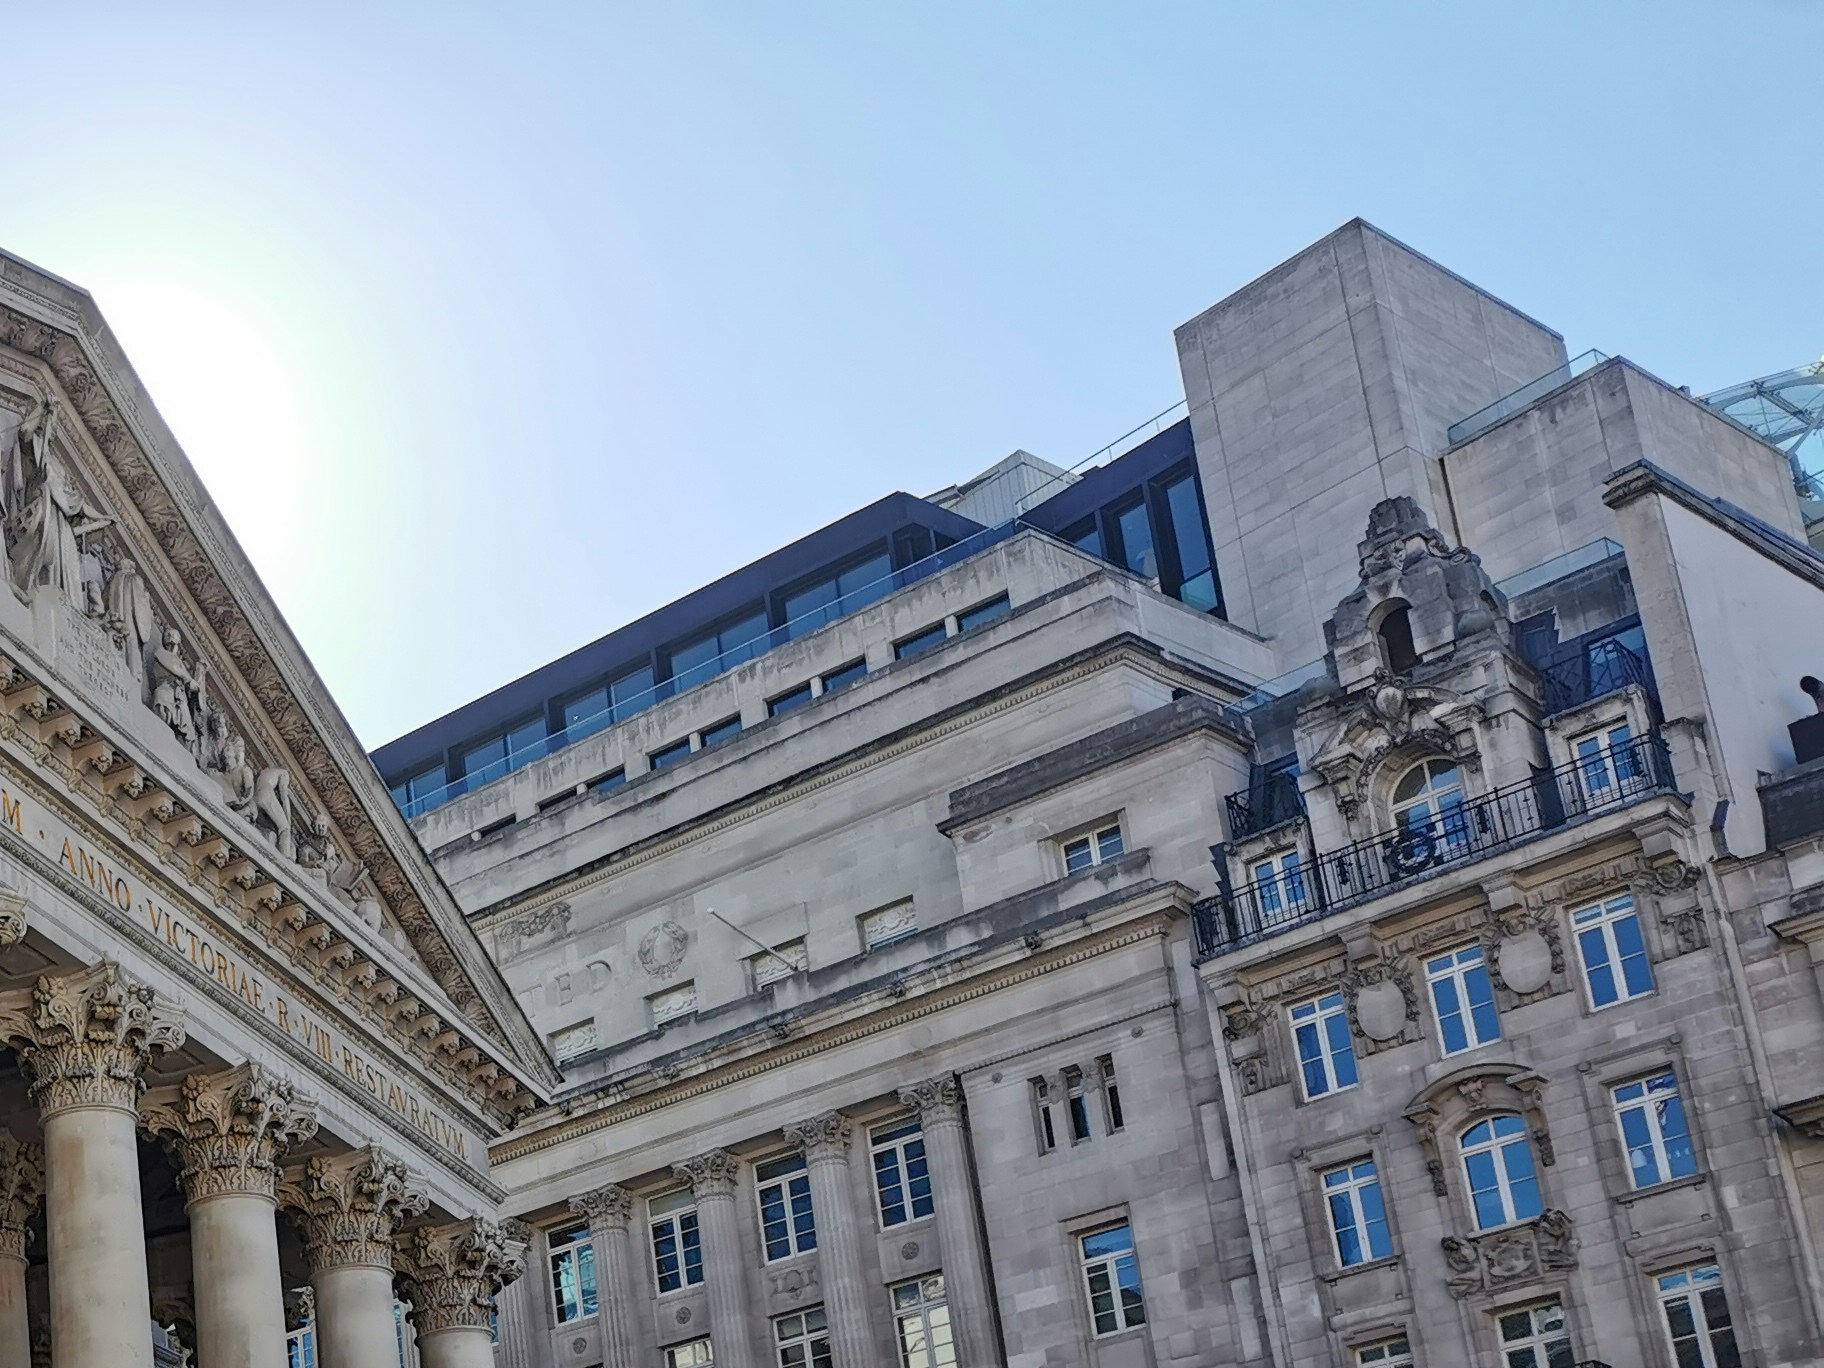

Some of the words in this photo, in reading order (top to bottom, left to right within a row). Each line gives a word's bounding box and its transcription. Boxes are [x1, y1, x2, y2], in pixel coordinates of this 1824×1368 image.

[59, 837, 131, 912] ANNO
[146, 898, 266, 1014] VICTORIAE
[277, 997, 291, 1034] R
[301, 1014, 333, 1064] VIII
